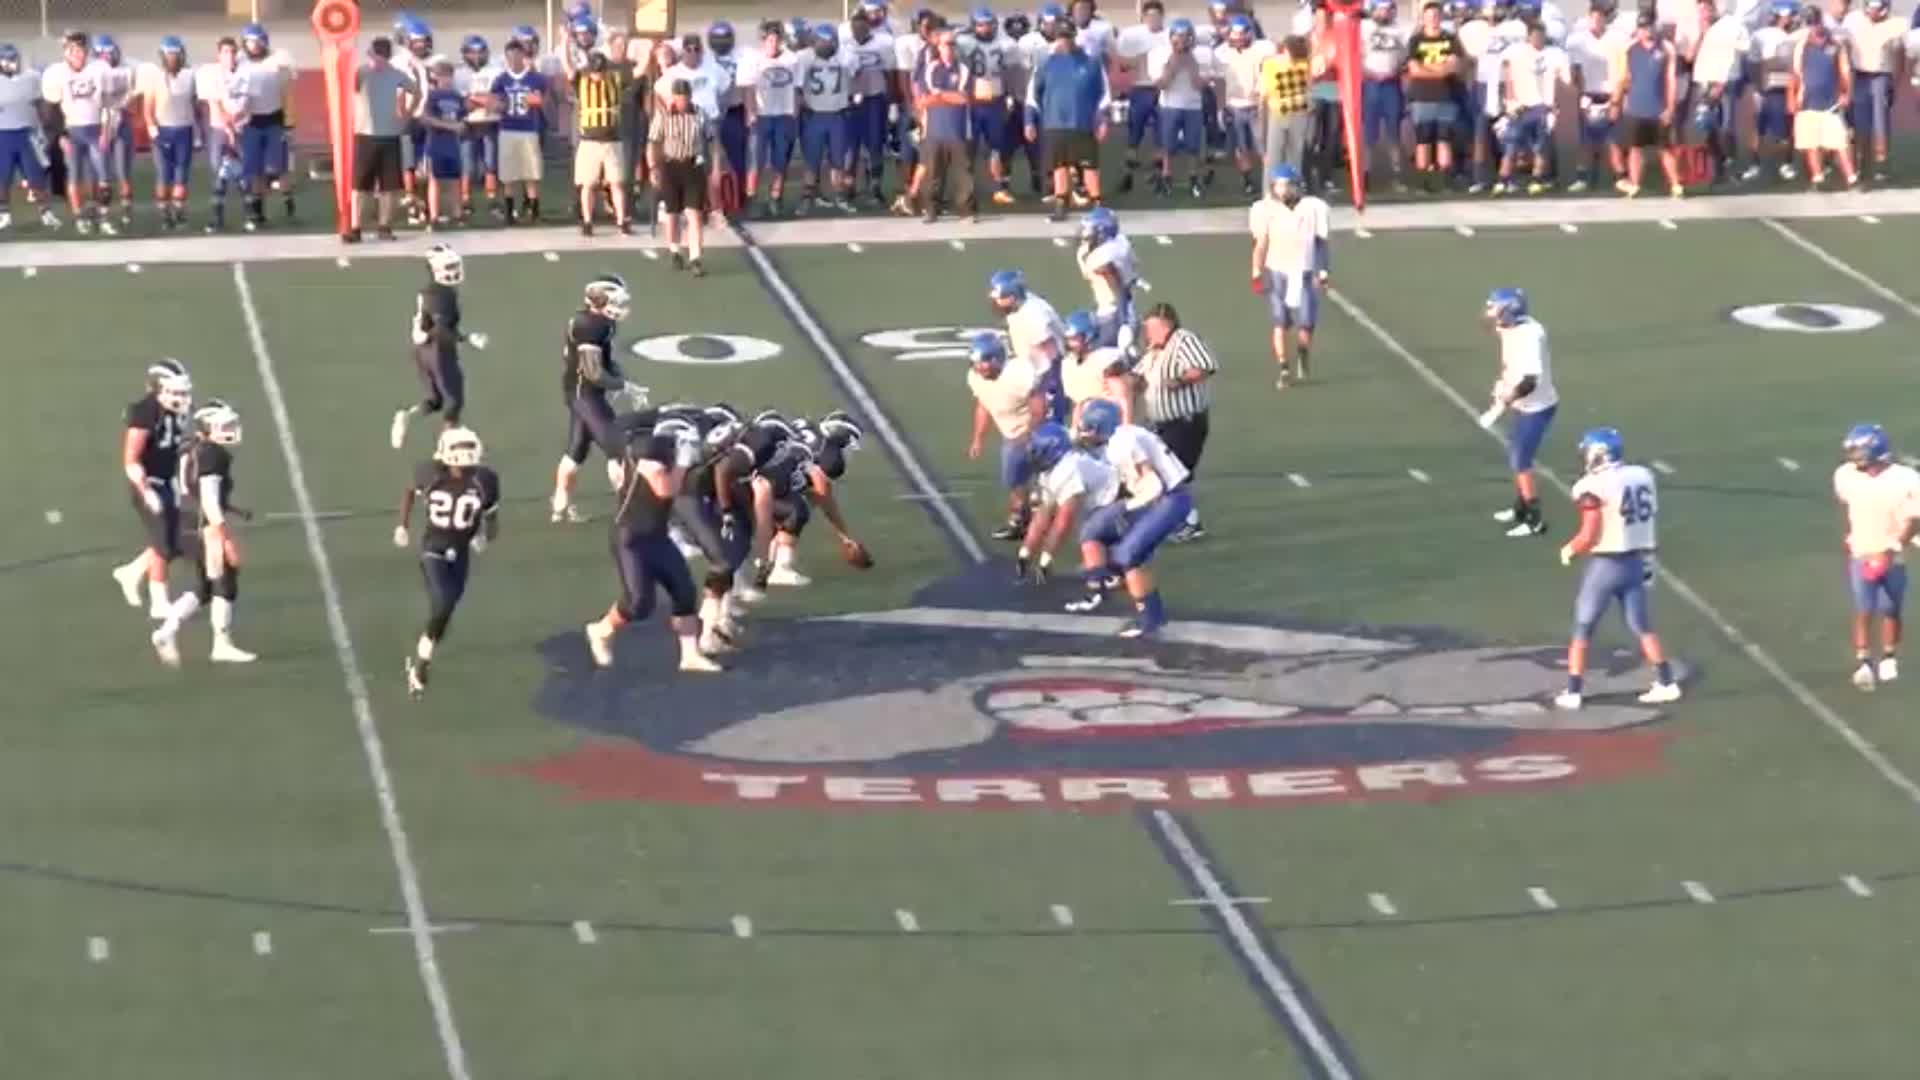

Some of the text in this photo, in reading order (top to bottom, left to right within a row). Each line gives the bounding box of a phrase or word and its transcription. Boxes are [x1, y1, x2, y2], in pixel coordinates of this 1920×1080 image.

[807, 65, 842, 95] 57
[429, 490, 481, 530] 20
[1619, 485, 1652, 526] 46
[702, 753, 1578, 802] TERRIERS
